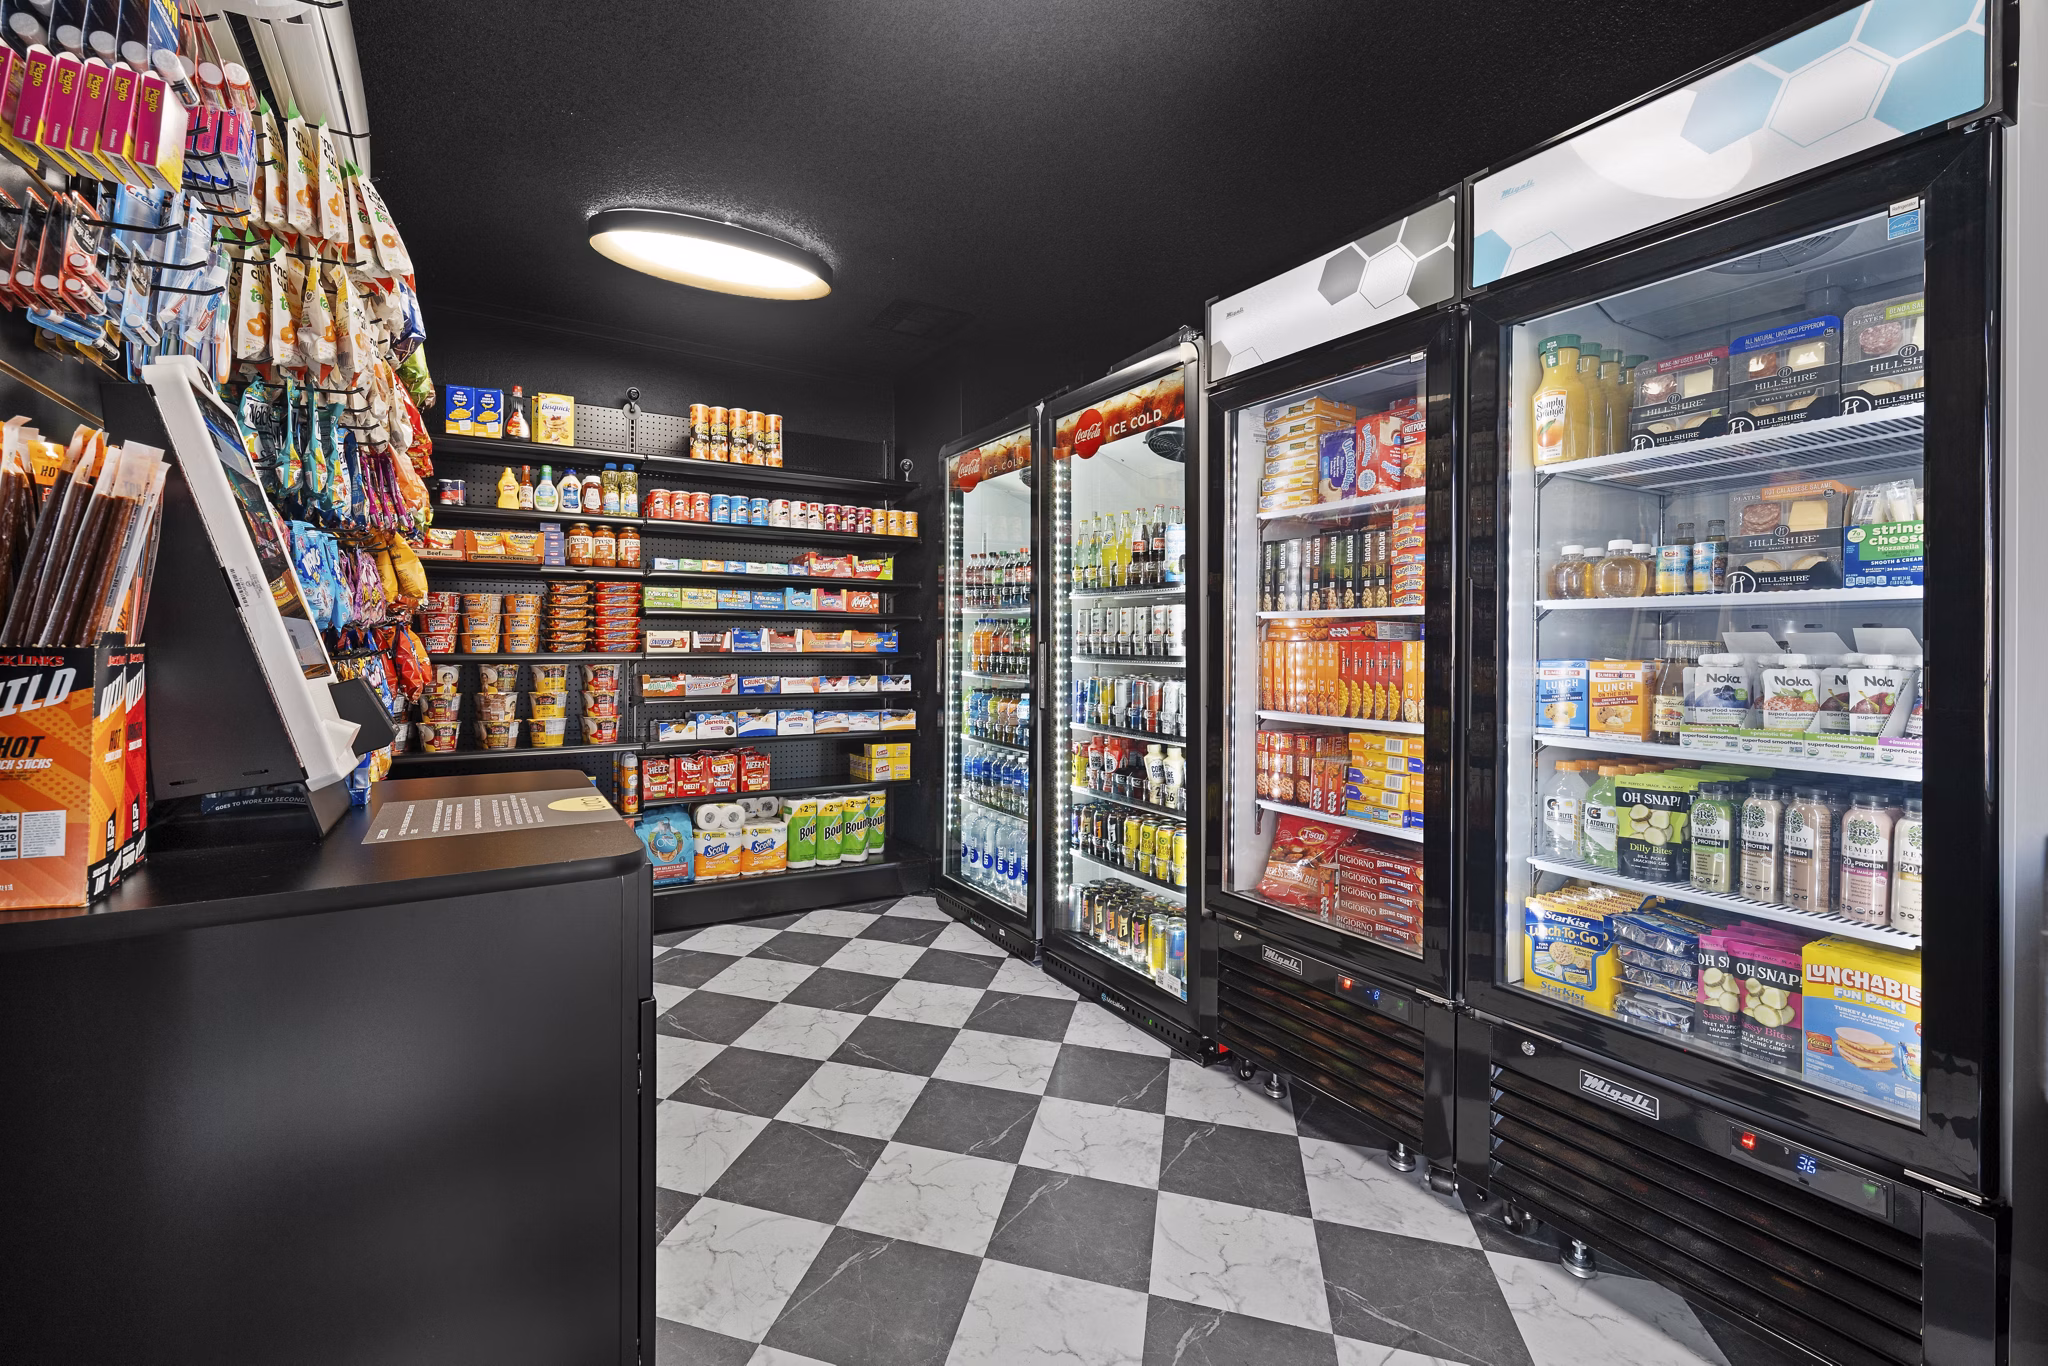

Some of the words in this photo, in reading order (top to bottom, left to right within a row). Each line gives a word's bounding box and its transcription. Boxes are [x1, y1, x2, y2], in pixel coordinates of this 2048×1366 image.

[34, 62, 47, 87] Pepto
[62, 70, 77, 95] Pepto
[90, 74, 105, 99] Pepto
[118, 77, 131, 102] Pepto
[149, 88, 161, 113] Pepto
[125, 184, 161, 211] Crest
[1889, 305, 1910, 315] GENOA
[1852, 315, 1884, 327] PLATES
[1744, 337, 1753, 350] ALL
[1775, 327, 1798, 342] UNCURED
[1798, 321, 1825, 335] PEPPERONI
[1659, 354, 1693, 369] WINE-INFUSED
[1693, 350, 1714, 361] SALAME
[1754, 373, 1818, 393] HILLSHIRE
[1761, 395, 1781, 404] SMALL
[1785, 390, 1811, 400] PLATES
[541, 402, 572, 414] Bisquick
[1646, 399, 1703, 418] HILLSHIRE
[1109, 423, 1127, 437] ICE
[1130, 409, 1162, 430] COLD
[1757, 413, 1808, 427] HILLSHIRE
[1403, 424, 1414, 435] HOT
[1656, 430, 1700, 444] HILLSHIRE
[985, 466, 998, 477] ICE
[1001, 456, 1024, 471] COLD
[1341, 437, 1355, 491] Uncrustables
[1776, 484, 1809, 496] CALABRESE
[1810, 481, 1833, 491] SALAME
[1872, 523, 1924, 536] string
[570, 535, 590, 545] Prego
[593, 536, 613, 546] Prego
[1748, 534, 1818, 549] HILLSHIRE
[1877, 543, 1920, 552] Mozzarella
[812, 563, 838, 572] Skittles
[1871, 558, 1895, 566] SMOOTH
[856, 565, 881, 573] Skittles
[1395, 567, 1408, 576] Bagel
[1395, 582, 1408, 590] Bagel
[1757, 574, 1810, 585] HILLSHIRE
[1394, 597, 1408, 606] Bagel
[1408, 594, 1421, 602] Bites
[650, 638, 674, 646] SNICKERS
[743, 677, 768, 686] CRUNCH
[1544, 678, 1579, 690] LUNCH
[1705, 673, 1741, 685] Noka
[1773, 675, 1812, 687] Noka
[1863, 676, 1895, 688] Noka
[648, 682, 666, 692] Milky
[1596, 681, 1634, 693] LUNCH
[1699, 707, 1728, 715] superfood
[704, 719, 730, 727] donettes
[784, 716, 808, 724] donettes
[1681, 732, 1708, 741] superfood
[1708, 733, 1738, 741] smoothies
[1740, 737, 1770, 746] superfood
[1770, 738, 1802, 747] smoothies
[1749, 731, 1778, 740] +prebiotic
[1778, 731, 1793, 739] fiber
[1815, 734, 1846, 743] +prebiotic
[1847, 736, 1864, 744] fiber
[1806, 741, 1838, 751] superfood
[1840, 744, 1874, 753] smoothies
[1887, 739, 1920, 748] +immune
[1880, 747, 1917, 757] superfood
[16, 757, 54, 770] STICKS
[215, 803, 231, 811] GOES
[232, 800, 241, 808] TO
[242, 798, 263, 806] WORK
[274, 796, 306, 804] SECOND
[1622, 791, 1641, 804] OH
[1643, 793, 1681, 807] SNAP!
[656, 837, 676, 848] ONE
[753, 838, 776, 854] Scott
[1697, 838, 1721, 847] PROTEIN
[706, 842, 728, 859] Scott
[1629, 843, 1651, 855] Dilly
[1651, 846, 1673, 857] Bites
[1844, 844, 1885, 857] REMEDY
[1340, 854, 1375, 870] DIGIORNO
[1376, 859, 1394, 870] RISING
[1394, 867, 1411, 876] CRUST
[1632, 858, 1656, 867] SNACKING
[1855, 860, 1884, 870] PROTEIN
[1341, 870, 1378, 887] DIGIORNO
[1379, 876, 1397, 887] RISING
[1396, 880, 1414, 893] CRUST
[1341, 885, 1377, 901] DIGIORNO
[1378, 891, 1396, 902] RISING
[1396, 896, 1413, 909] CRUST
[1341, 900, 1377, 917] DIGIORNO
[1379, 907, 1396, 918] RISING
[1396, 912, 1413, 924] CRUST
[1566, 907, 1578, 915] 260
[1578, 910, 1600, 921] Calories
[1544, 911, 1591, 930] StarKist
[1336, 915, 1374, 933] DIGIORNO
[1375, 923, 1392, 933] RISING
[1393, 928, 1410, 941] CRUST
[1265, 947, 1301, 972] Migali
[1697, 952, 1715, 967] OH
[1736, 961, 1755, 978] OH
[1541, 979, 1586, 1001] StarKist
[1833, 986, 1863, 1002] FUN
[1865, 991, 1907, 1015] PACK!
[1703, 1009, 1731, 1024] Sassy
[1834, 1004, 1860, 1017] TURKEY
[1867, 1012, 1905, 1029] AMERICAN
[1764, 1026, 1793, 1042] Bites
[1768, 1042, 1786, 1053] CHIPS
[1775, 1040, 1796, 1050] PICKLE
[1582, 1073, 1656, 1117] Migali
[1796, 1155, 1817, 1175] 36
